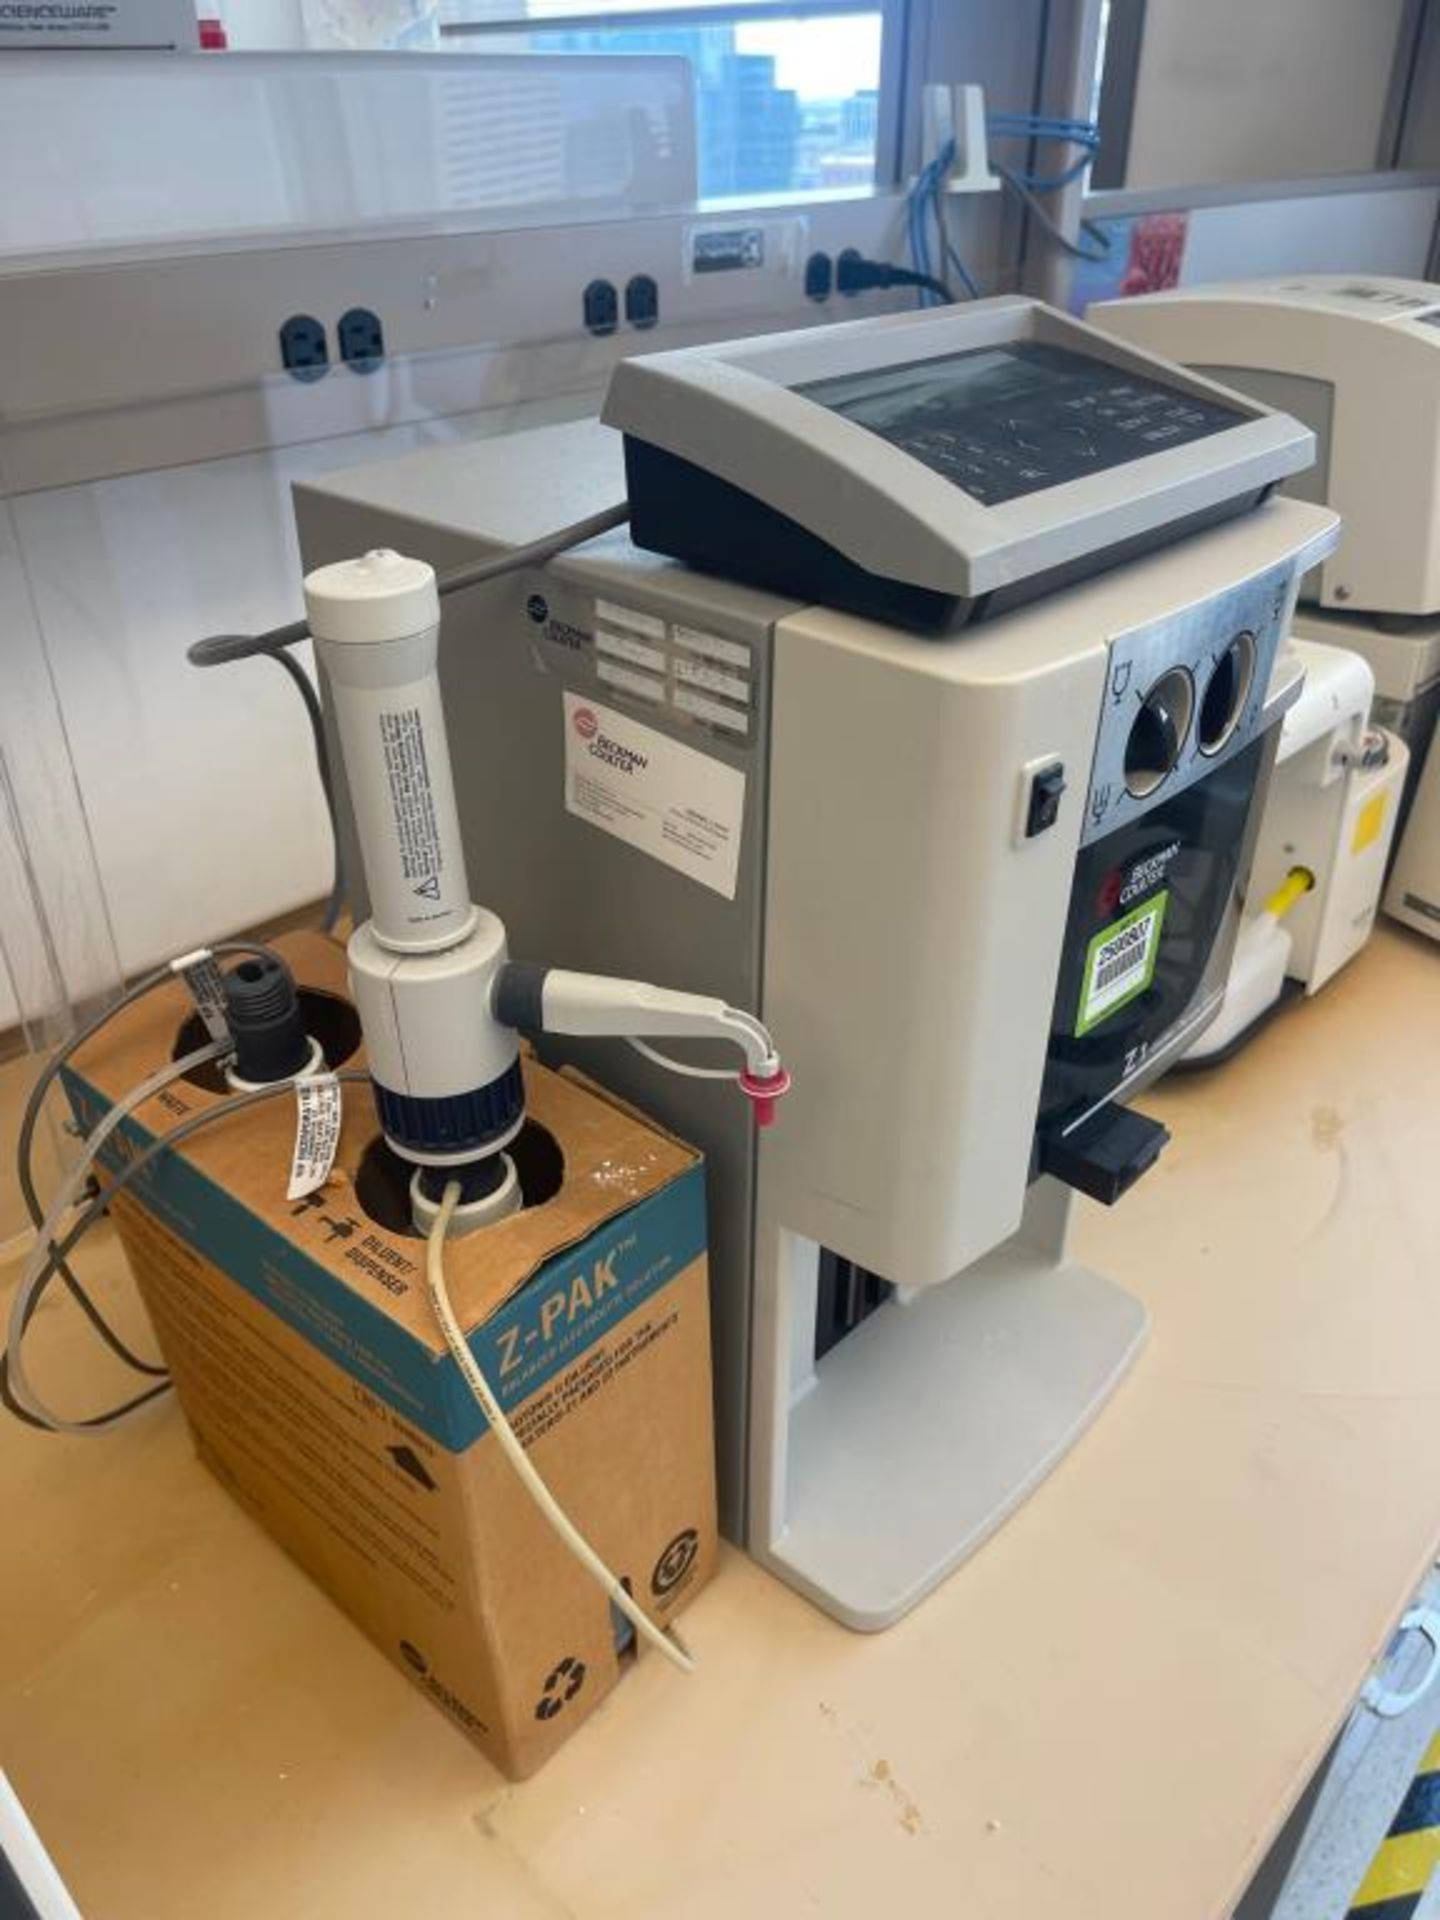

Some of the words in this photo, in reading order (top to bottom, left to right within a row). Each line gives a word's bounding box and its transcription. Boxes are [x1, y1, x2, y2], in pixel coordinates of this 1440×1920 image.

[588, 743, 634, 775] COULTER
[596, 733, 649, 770] BECKMAN
[1131, 840, 1181, 885] BECKMAN
[1119, 864, 1167, 904] COULTER
